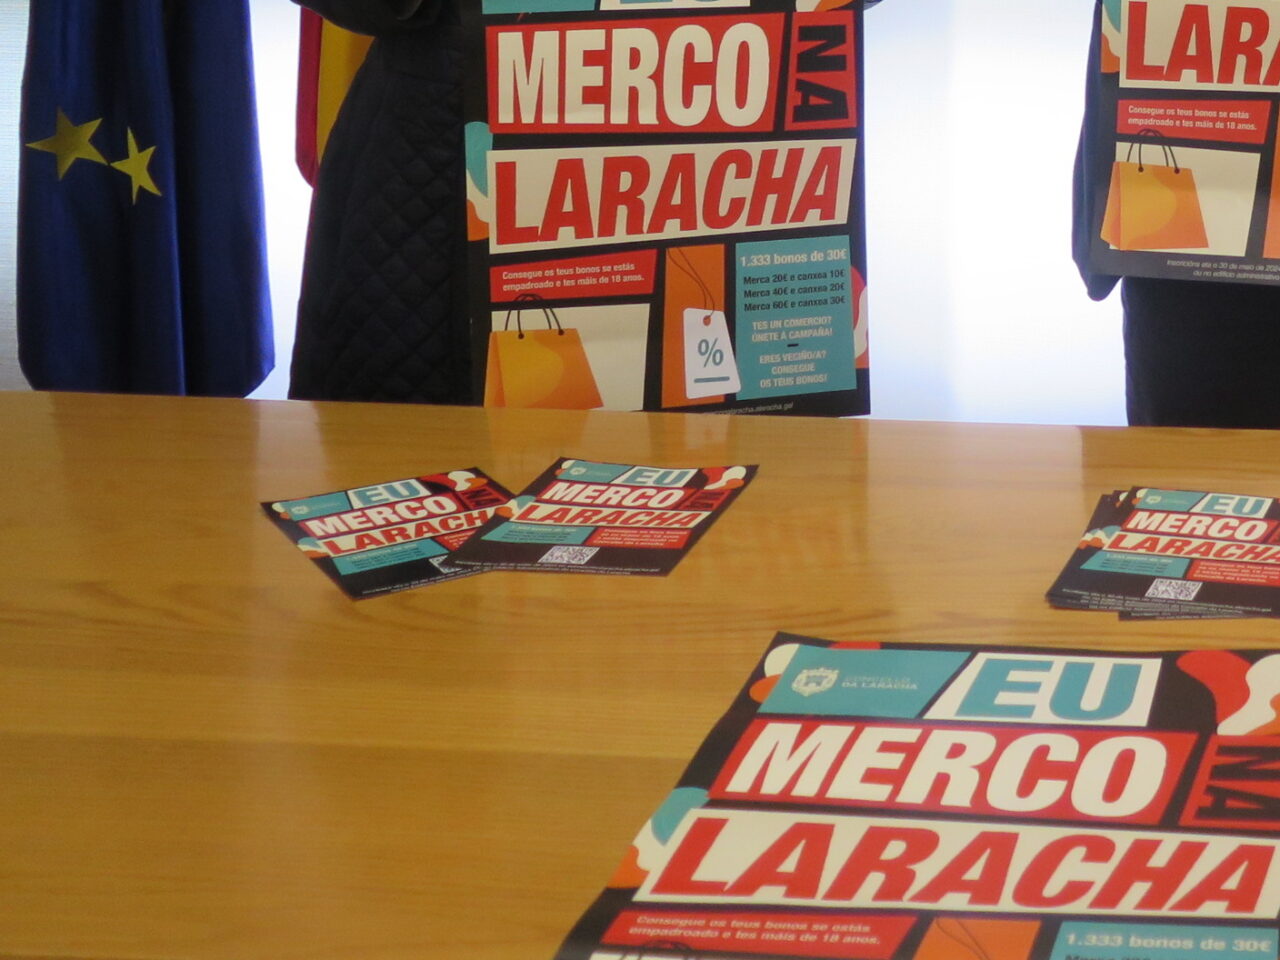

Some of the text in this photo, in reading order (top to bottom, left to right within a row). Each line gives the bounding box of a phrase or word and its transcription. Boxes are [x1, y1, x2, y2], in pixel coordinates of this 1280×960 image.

[498, 22, 770, 127] MERCO
[792, 24, 851, 124] NA
[495, 145, 842, 246] LARACHA
[740, 248, 847, 267] 1.333 bonos de 30€
[354, 481, 423, 505] EU
[541, 481, 684, 507] MERCO
[622, 468, 684, 486] EU
[305, 496, 457, 537] MERCO
[515, 505, 703, 528] LARACHA
[1198, 495, 1266, 516] EU
[323, 509, 489, 555] LARACH
[1127, 512, 1268, 541] MERCO
[954, 658, 1144, 721] EU
[725, 724, 1168, 818] MERCO
[649, 817, 1276, 915] LARACHA
[1067, 933, 1272, 952] 1.333 bonos de 30€
